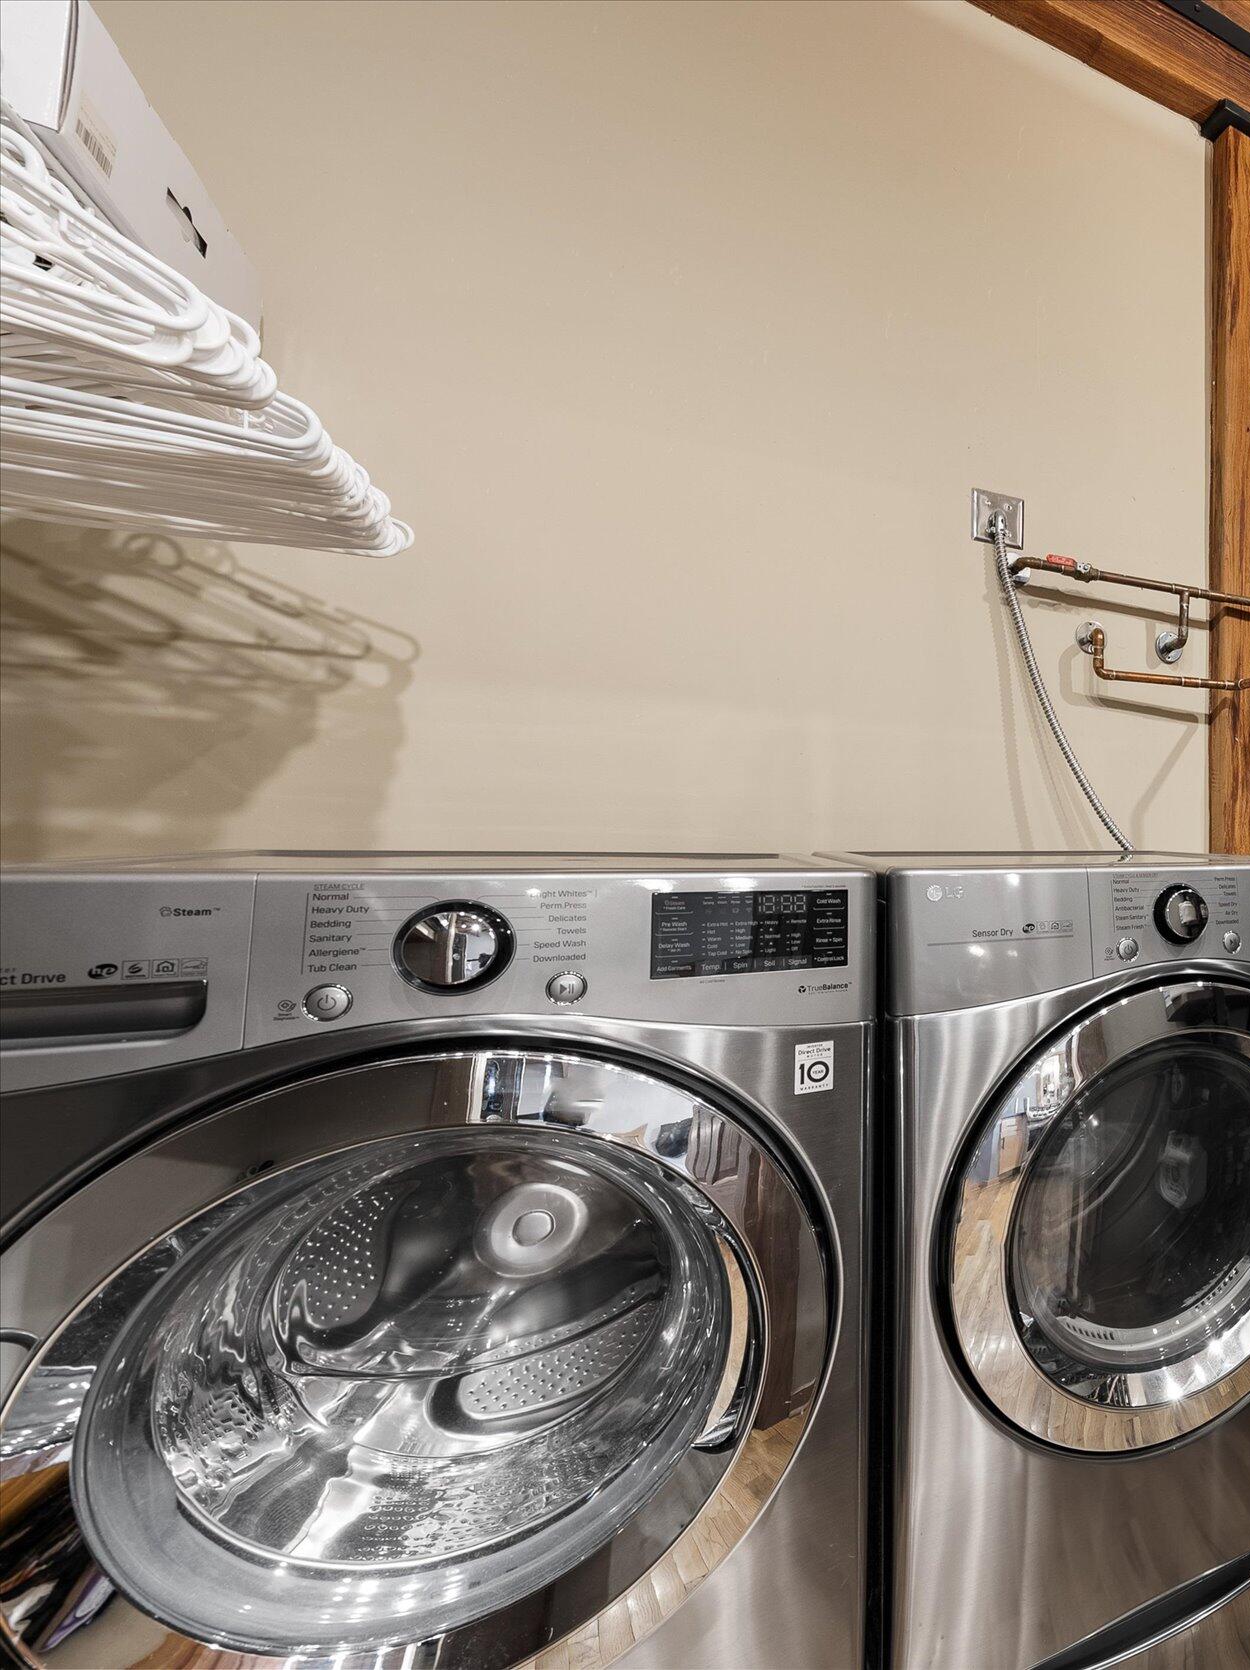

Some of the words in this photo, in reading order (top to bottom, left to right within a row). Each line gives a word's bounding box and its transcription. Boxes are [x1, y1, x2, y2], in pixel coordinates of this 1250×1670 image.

[312, 893, 350, 901] Normal
[945, 886, 964, 899] LG
[311, 906, 344, 916] Heavy
[345, 905, 370, 914] Duty
[548, 915, 587, 923] Delicates
[310, 920, 352, 930] Bedding
[557, 927, 587, 935] Towels
[972, 929, 999, 938] Sensor
[1000, 927, 1013, 937] Dry
[309, 934, 352, 943] Sanitary
[534, 941, 561, 950] Speed
[562, 940, 587, 948] Wash
[533, 953, 587, 963] Downloaded
[788, 958, 807, 966] Signal
[308, 964, 328, 973] Tub
[328, 963, 357, 972] Clean
[21, 973, 66, 985] Drive
[799, 1061, 830, 1085] 10
[800, 1083, 829, 1091] WARRANTY
